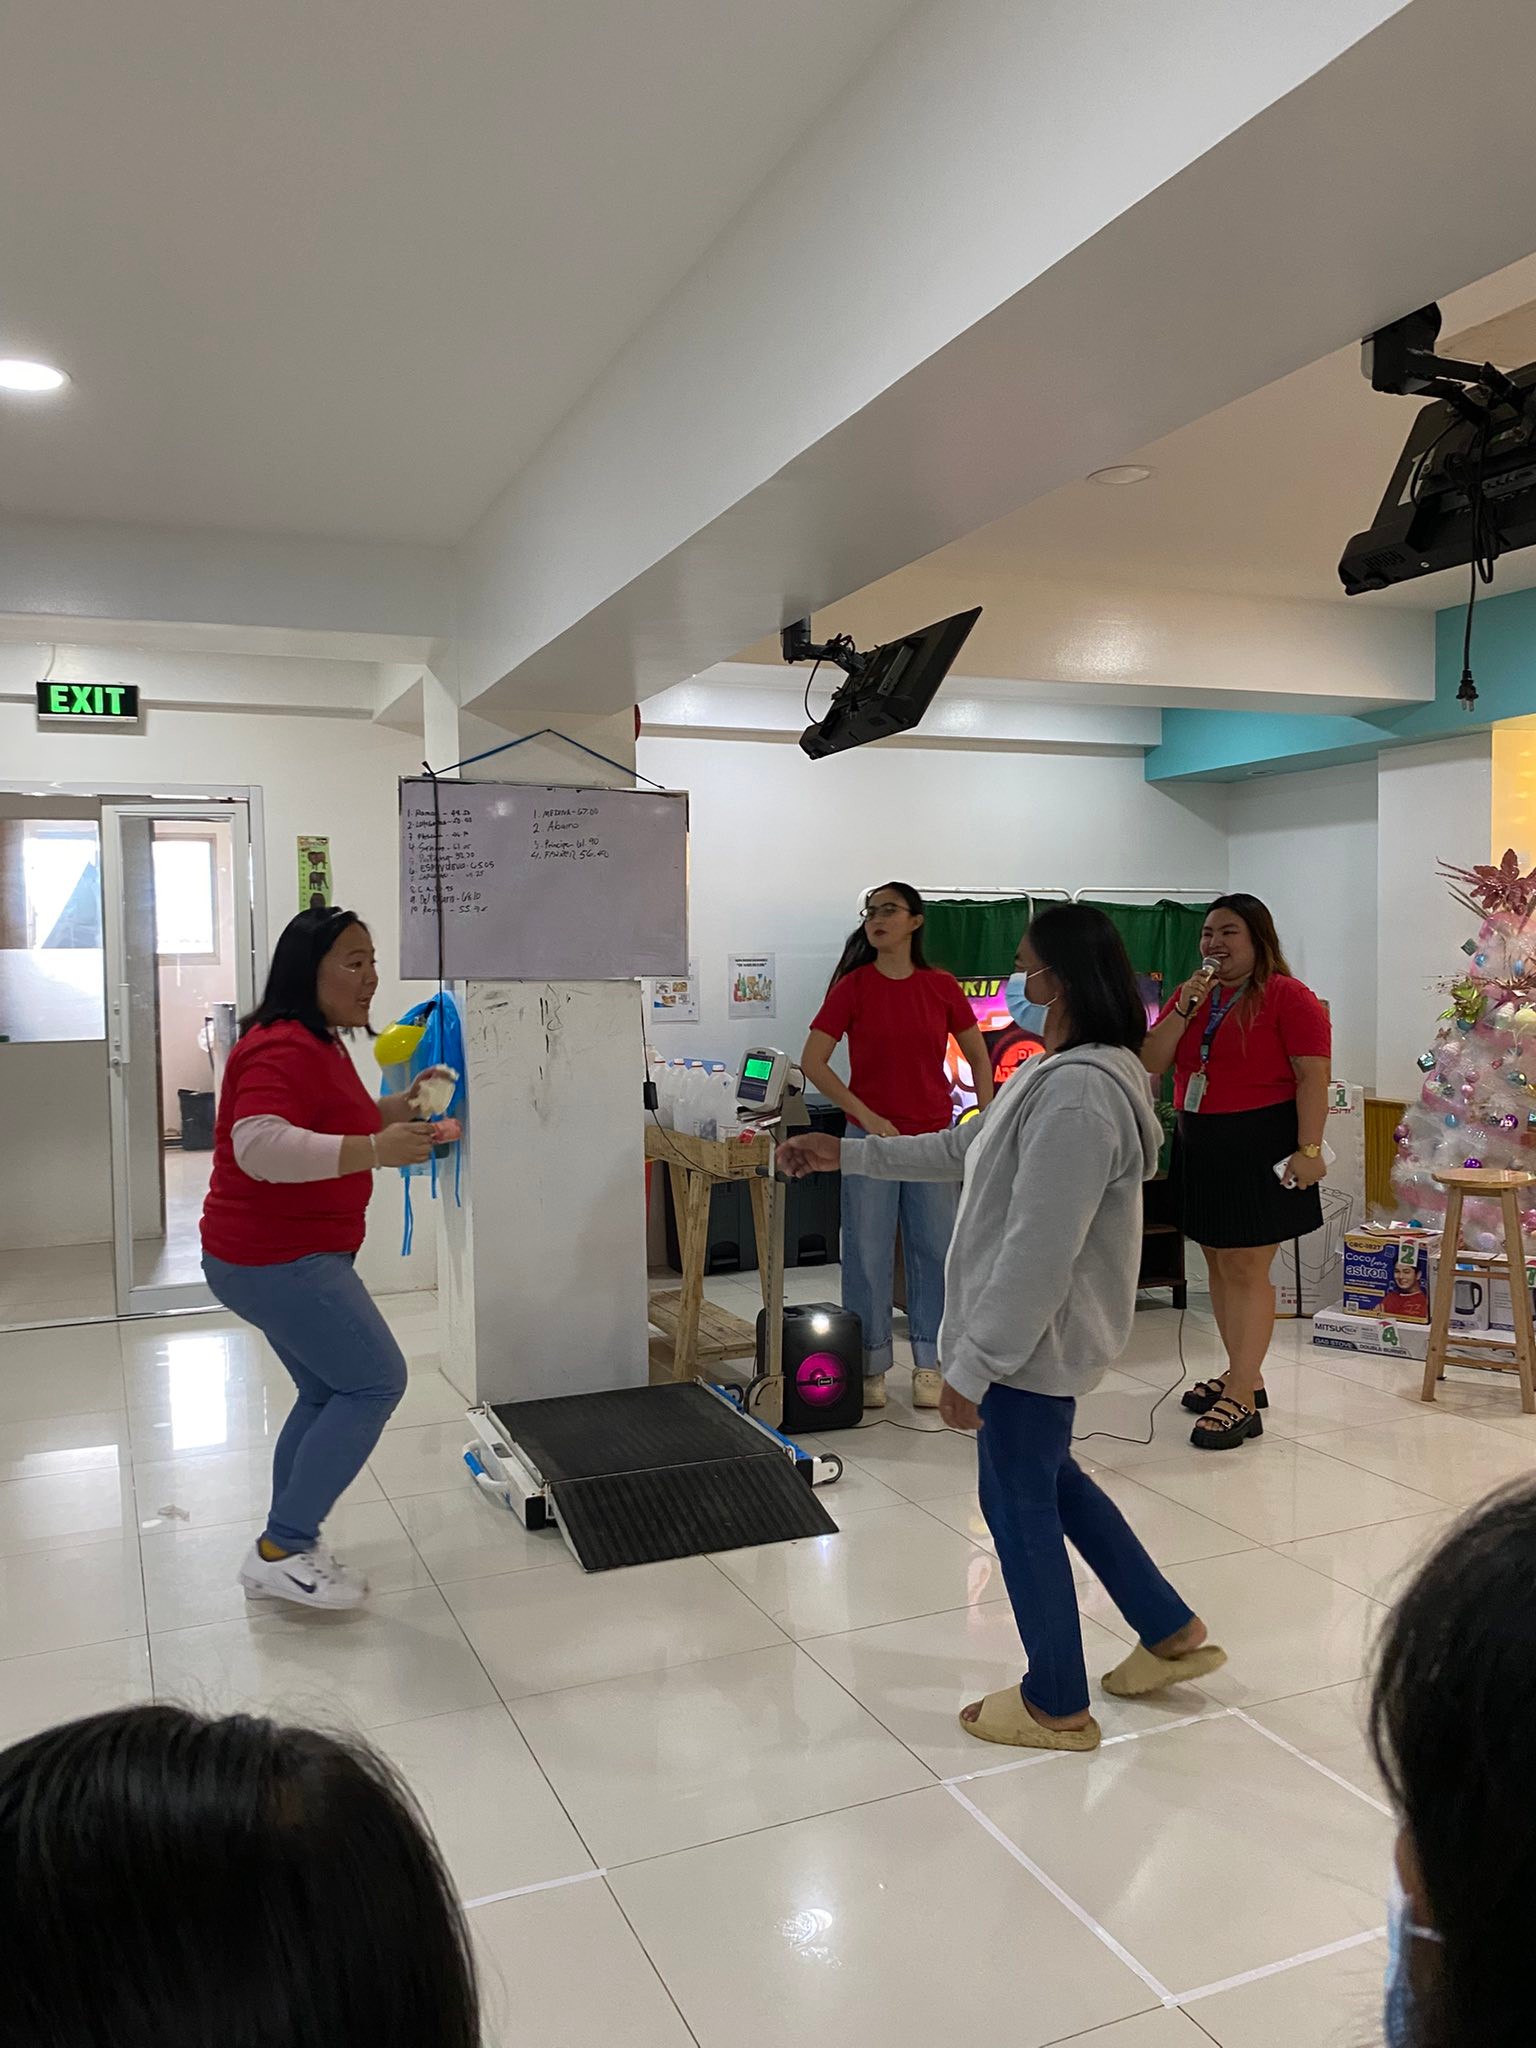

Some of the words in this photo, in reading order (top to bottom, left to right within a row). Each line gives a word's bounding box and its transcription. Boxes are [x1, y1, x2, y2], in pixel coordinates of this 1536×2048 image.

[50, 685, 125, 714] EXIT
[1400, 1244, 1415, 1265] 2
[1345, 1264, 1388, 1280] astron
[1382, 1326, 1398, 1346] 4
